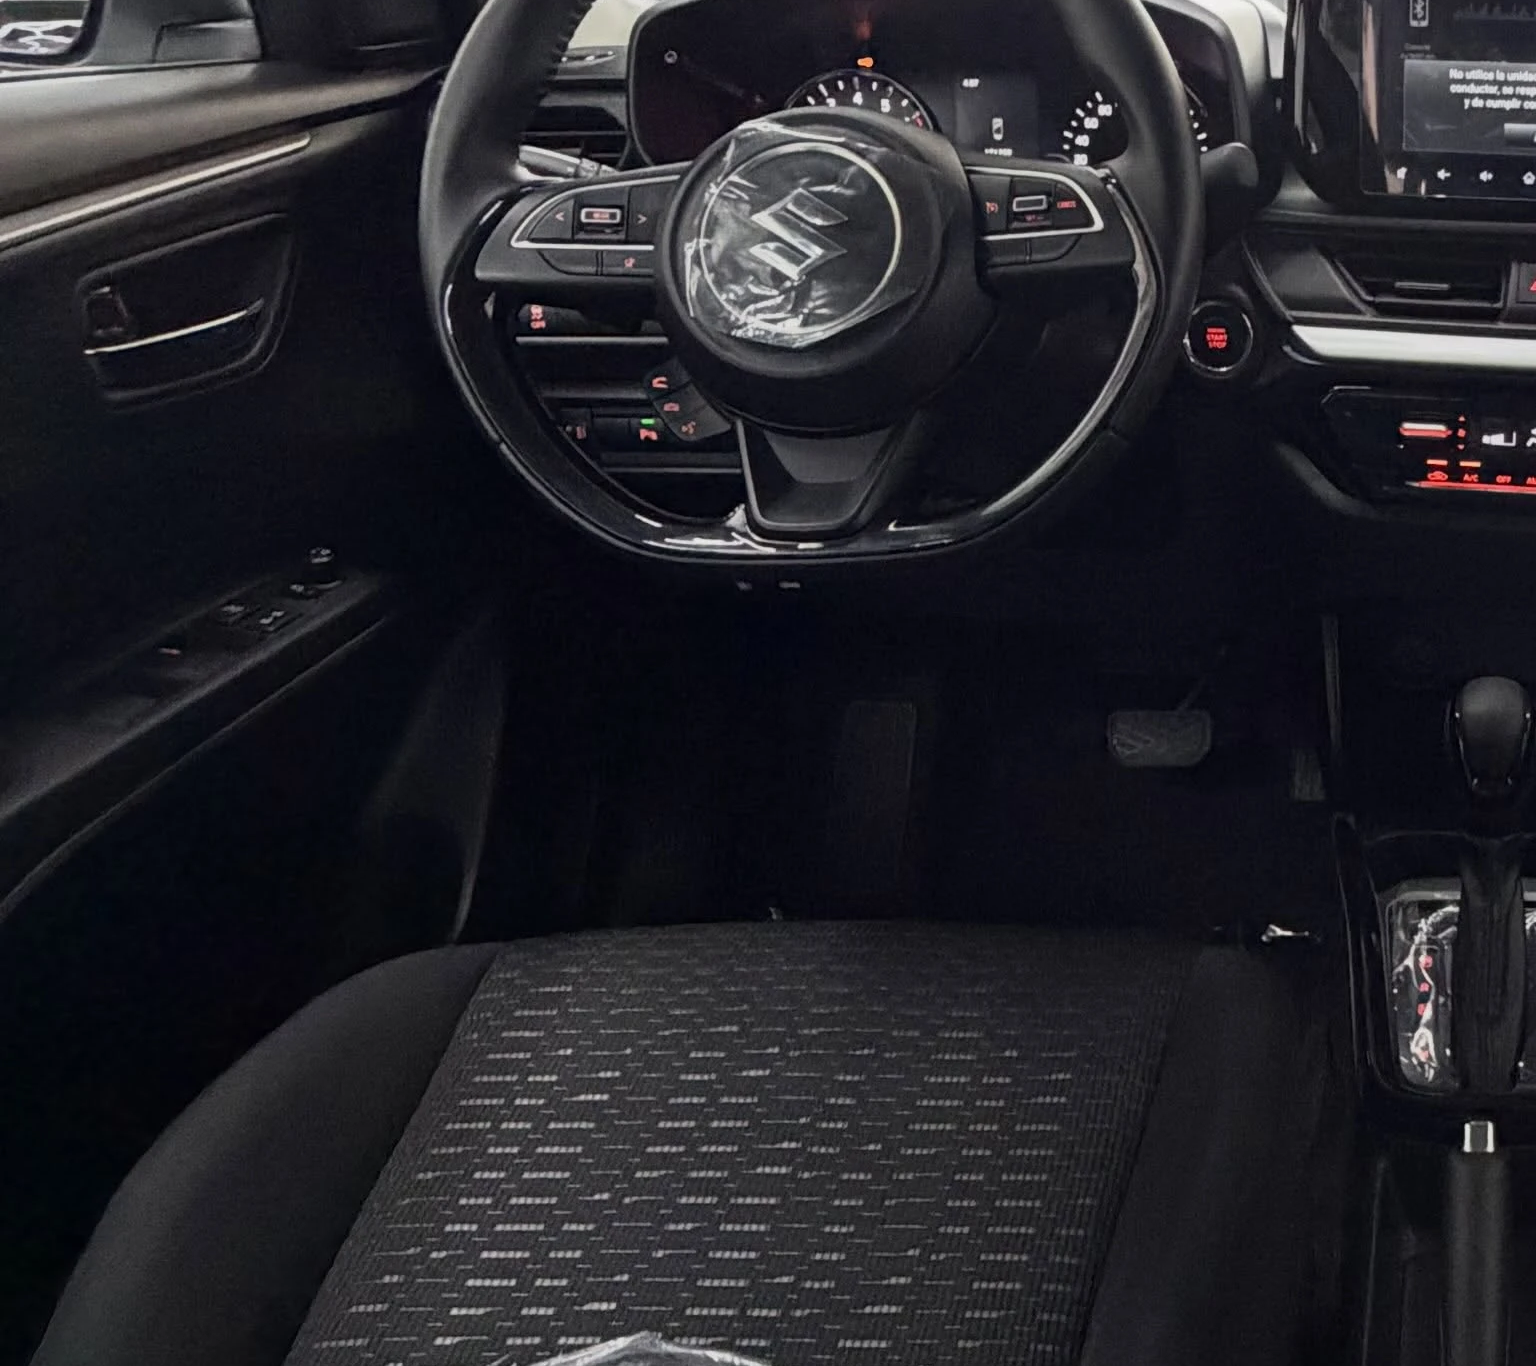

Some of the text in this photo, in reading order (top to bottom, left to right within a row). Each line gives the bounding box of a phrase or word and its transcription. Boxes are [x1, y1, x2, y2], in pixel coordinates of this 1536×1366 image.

[1449, 68, 1464, 80] No
[1465, 69, 1495, 81] utilice
[1496, 69, 1506, 82] la
[1449, 82, 1500, 96] conductor,
[853, 91, 863, 106] 4
[1464, 98, 1470, 110] y
[1471, 96, 1484, 108] de
[1485, 98, 1521, 111] cumplir
[880, 98, 891, 113] 5
[1075, 135, 1090, 147] 40
[1206, 333, 1228, 341] START
[1208, 341, 1227, 349] STOP
[1463, 473, 1479, 483] A/C
[1496, 475, 1512, 484] OFF
